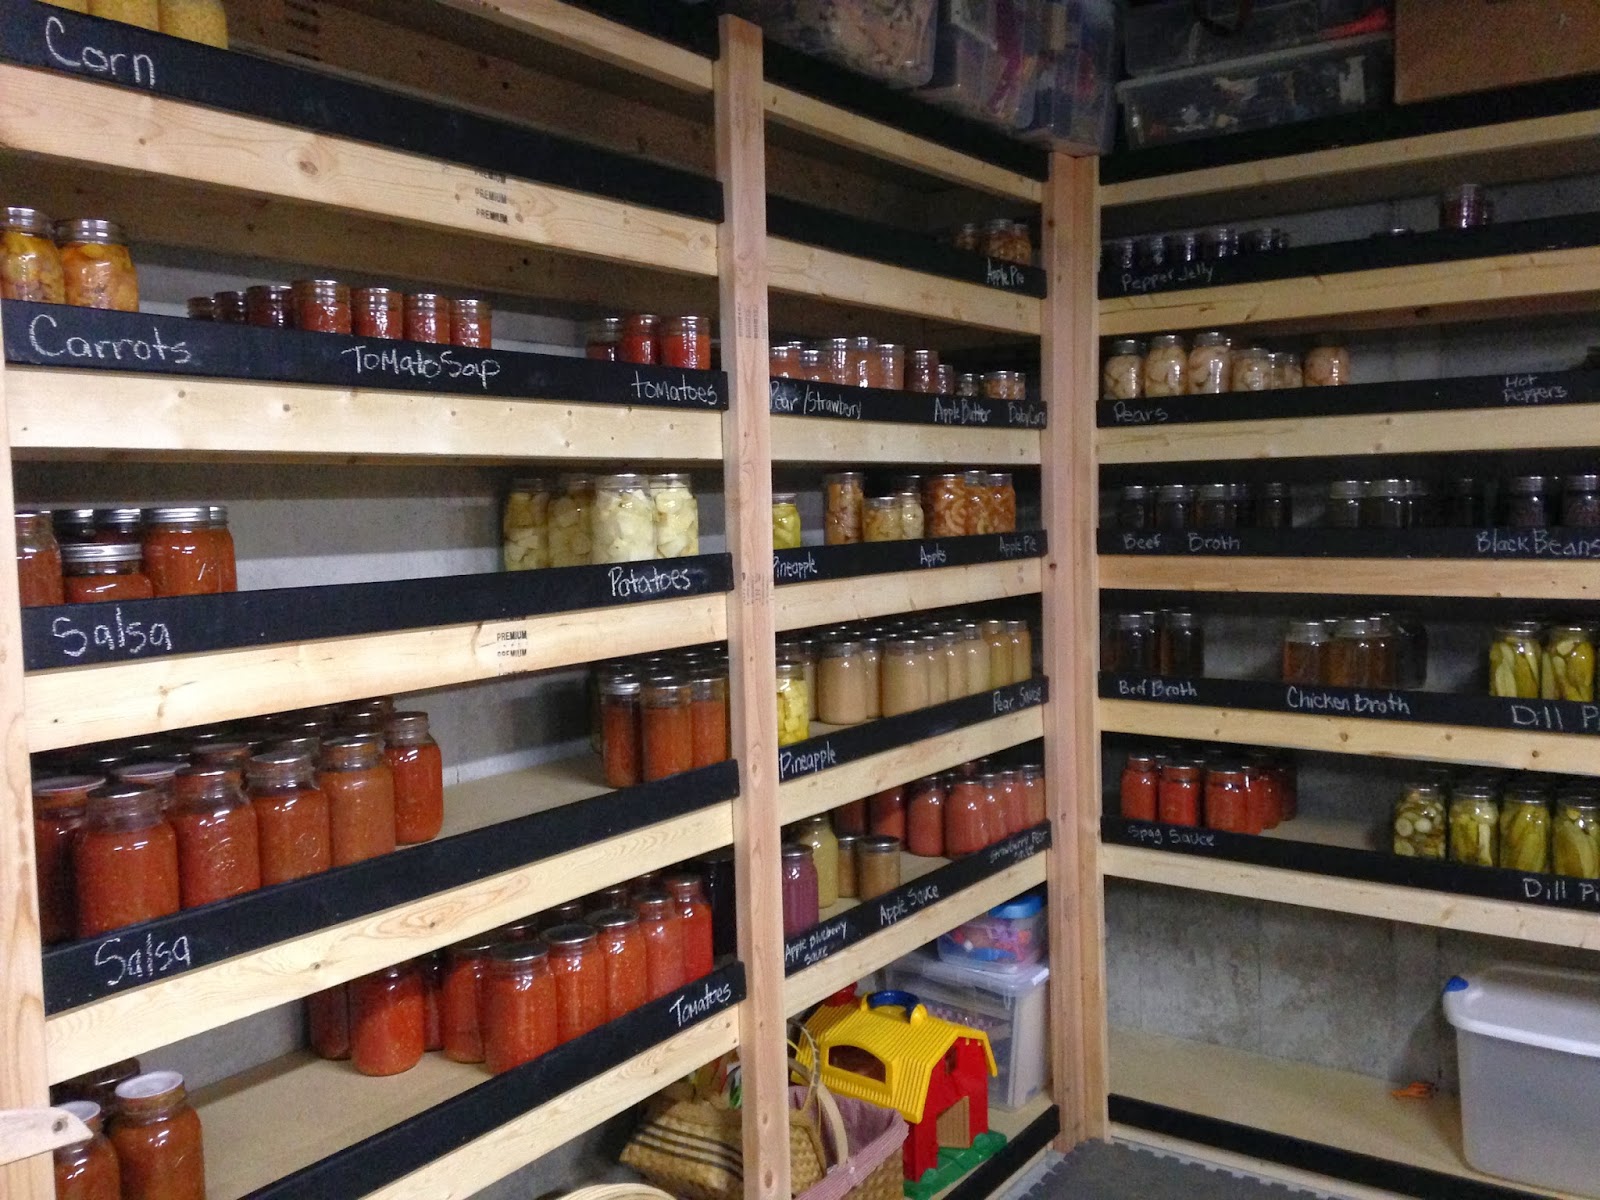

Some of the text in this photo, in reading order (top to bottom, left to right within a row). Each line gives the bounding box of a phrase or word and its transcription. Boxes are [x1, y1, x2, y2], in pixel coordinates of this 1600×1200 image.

[45, 16, 156, 88] Corn
[29, 314, 192, 364] Carrots
[1505, 374, 1538, 388] Hot
[1113, 401, 1169, 422] Pears
[1123, 533, 1162, 550] Beef
[1476, 528, 1530, 553] Black
[608, 566, 691, 597] Potatoes
[52, 604, 173, 657] Salsa
[496, 630, 527, 641] PREMIUM
[1286, 685, 1351, 711] Chicken
[1511, 705, 1563, 730] Dill
[779, 740, 837, 779] Pineapple
[1169, 829, 1215, 847] Sauce
[1523, 877, 1566, 901] Dill
[95, 932, 191, 986] Salsa
